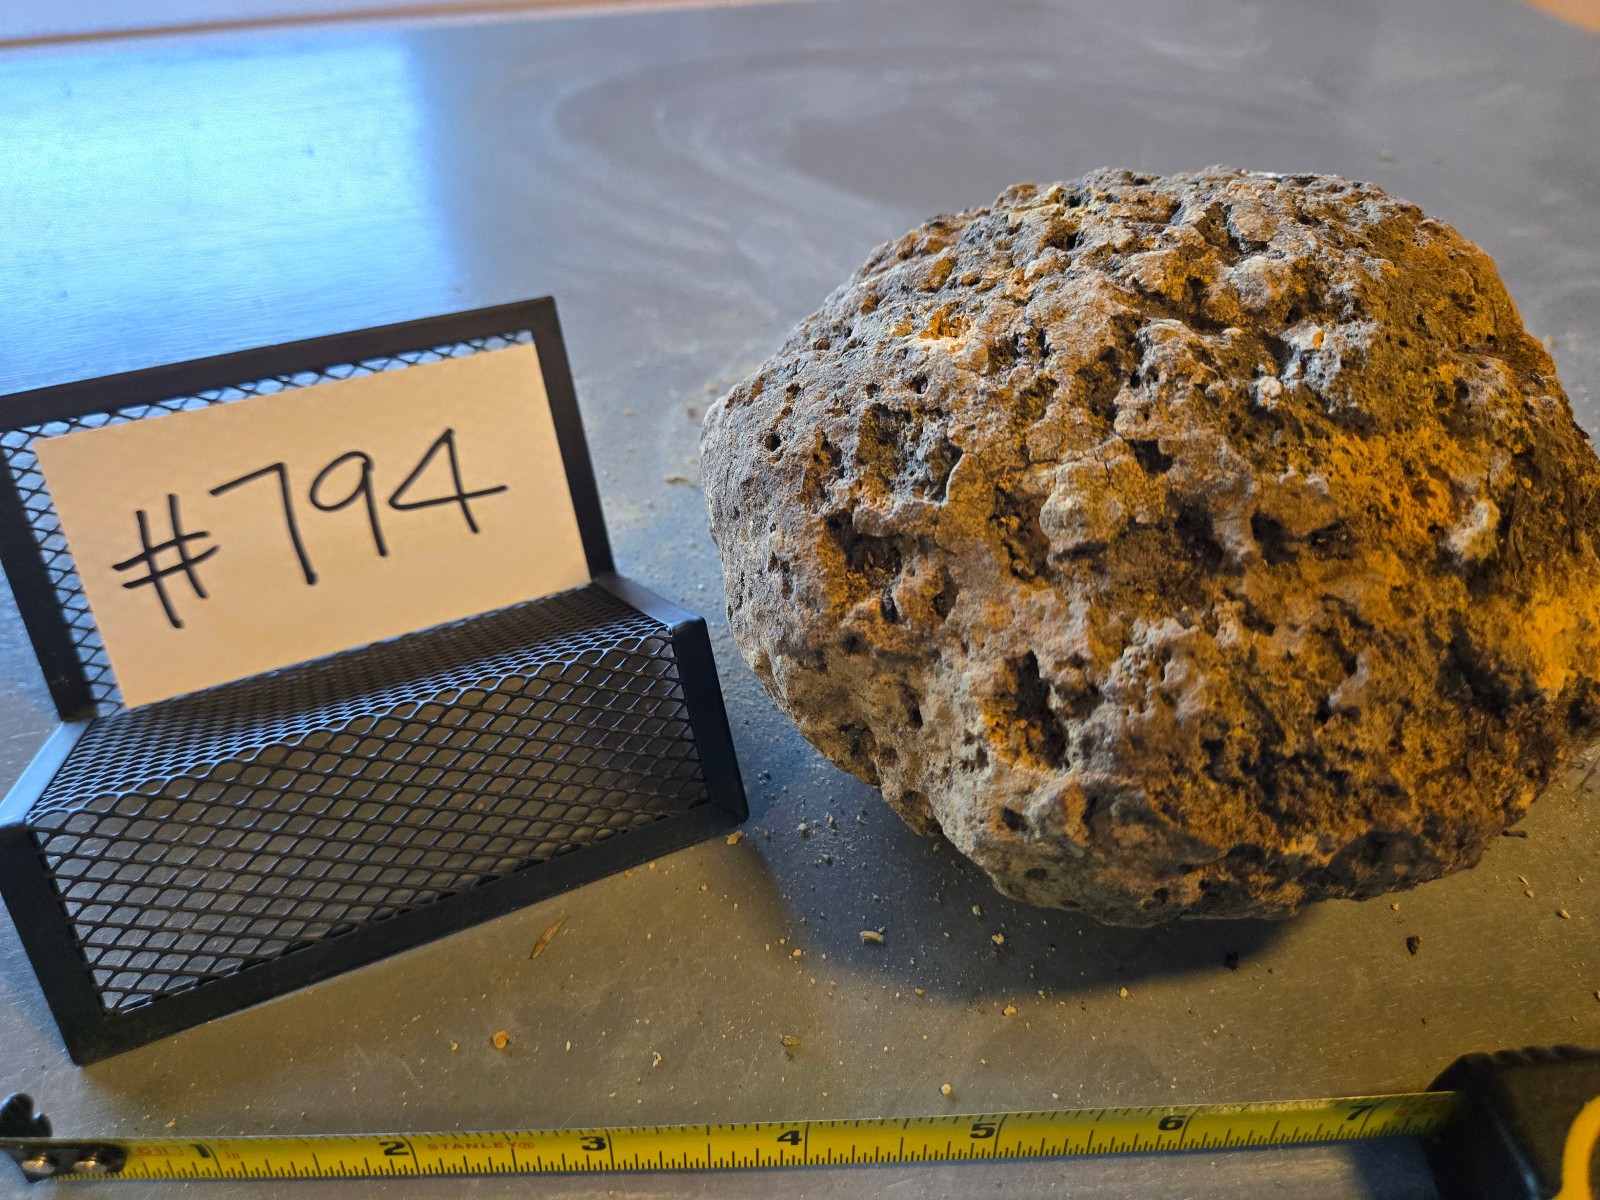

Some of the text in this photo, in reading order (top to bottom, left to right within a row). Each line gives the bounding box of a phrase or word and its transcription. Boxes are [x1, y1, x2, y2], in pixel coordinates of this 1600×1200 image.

[112, 428, 508, 629] #794
[189, 1143, 210, 1158] 1
[379, 1141, 410, 1156] 2
[579, 1136, 607, 1151] 3
[776, 1129, 803, 1146] 4
[969, 1122, 997, 1139] 5
[1157, 1114, 1186, 1131] 6
[1345, 1104, 1374, 1121] 7
